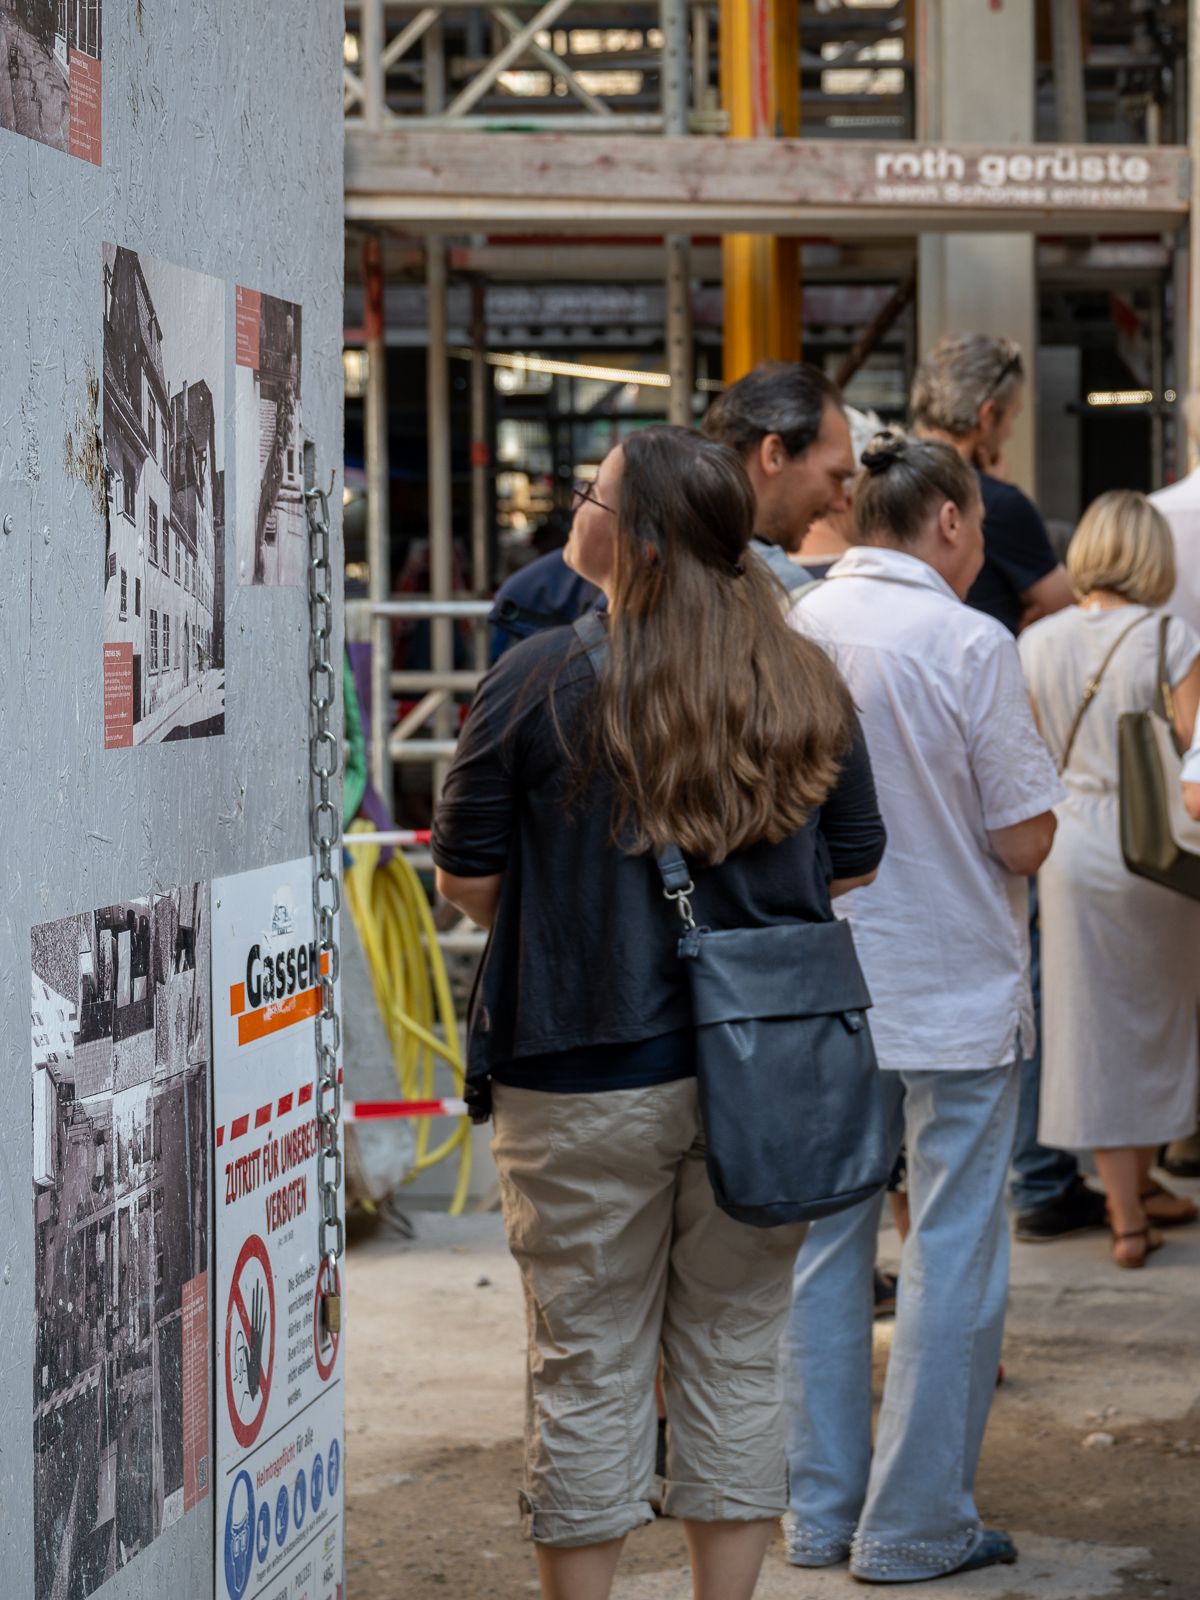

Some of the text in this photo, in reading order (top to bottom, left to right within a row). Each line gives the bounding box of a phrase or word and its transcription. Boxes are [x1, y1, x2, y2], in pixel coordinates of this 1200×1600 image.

[875, 150, 1150, 187] roth gerüste
[225, 1110, 331, 1206] ZUTRITT FÜR UNBERECH
[265, 1173, 307, 1236] VERBOTEN
